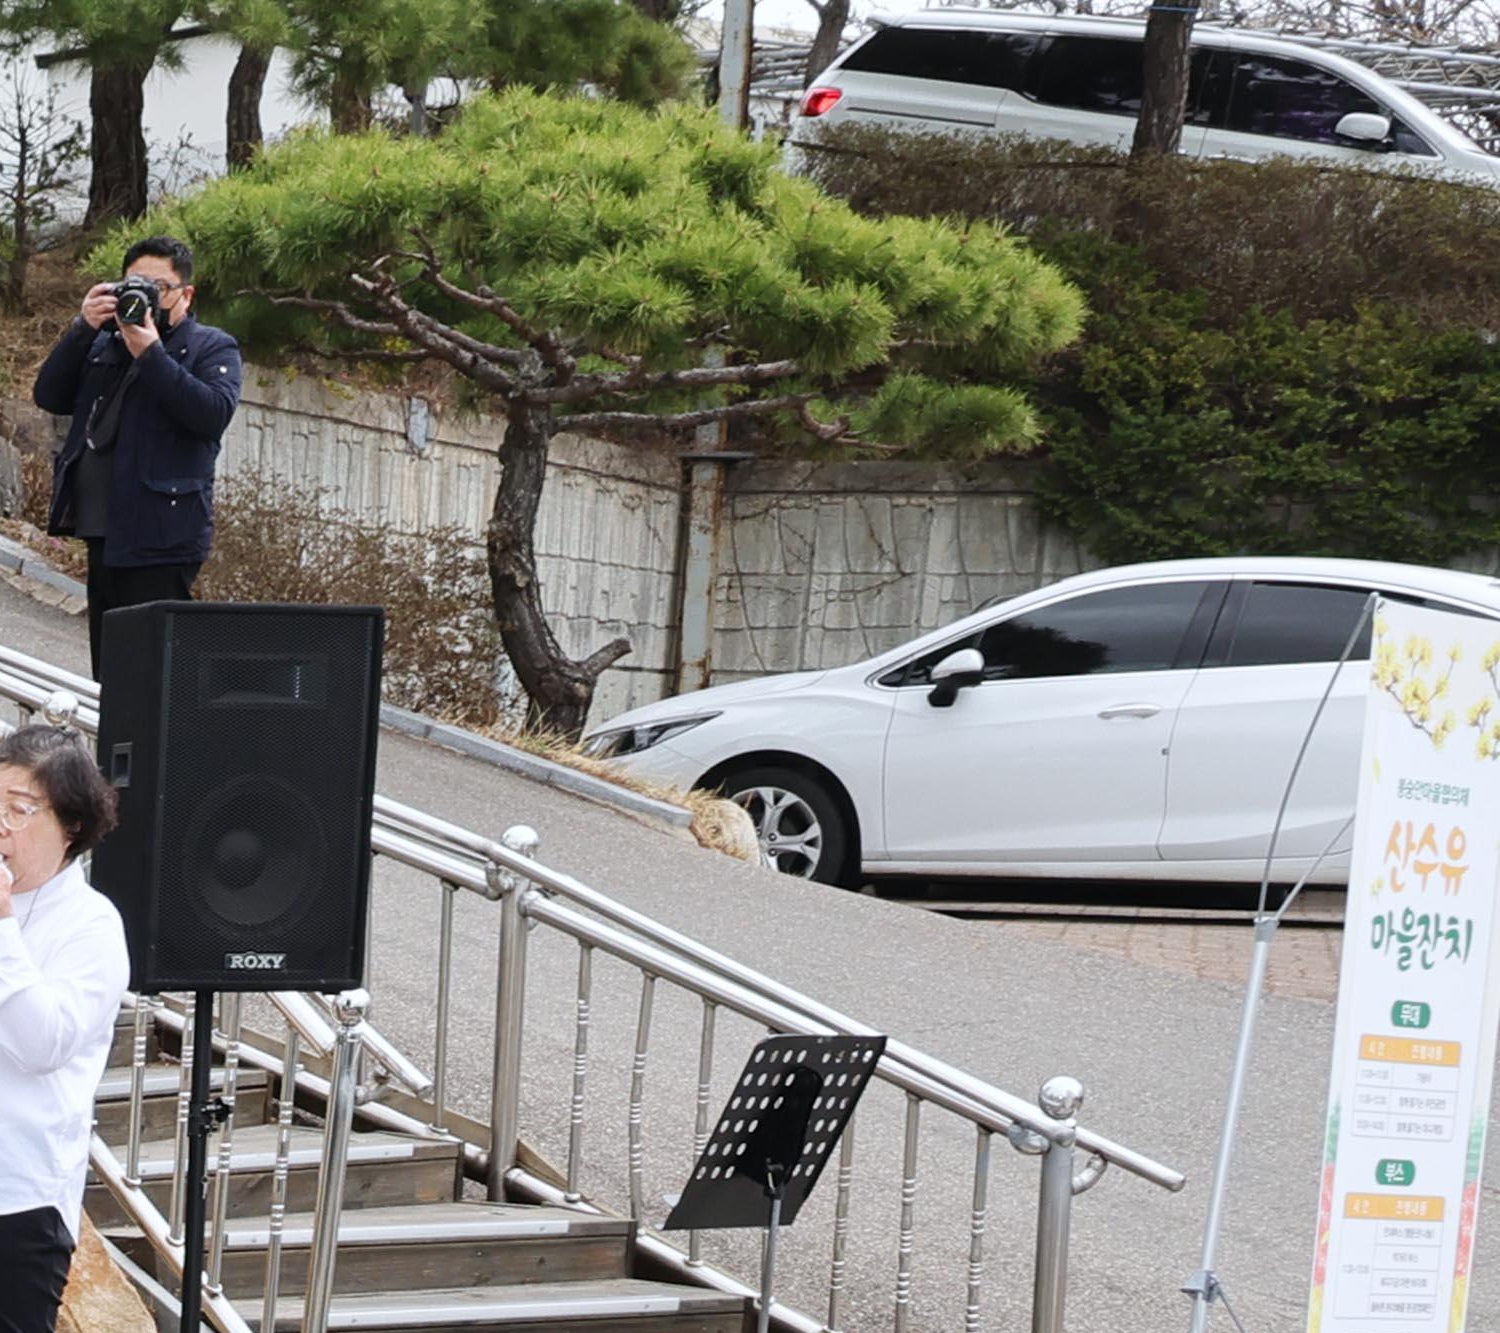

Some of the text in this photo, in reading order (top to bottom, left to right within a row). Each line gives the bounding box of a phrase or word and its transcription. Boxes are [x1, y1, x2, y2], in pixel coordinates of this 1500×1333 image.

[1383, 820, 1470, 897] 산수유
[1371, 906, 1474, 971] 마을잔치
[230, 956, 285, 969] ROXY
[1400, 1004, 1422, 1026] 무대
[1385, 1162, 1405, 1183] 부스
